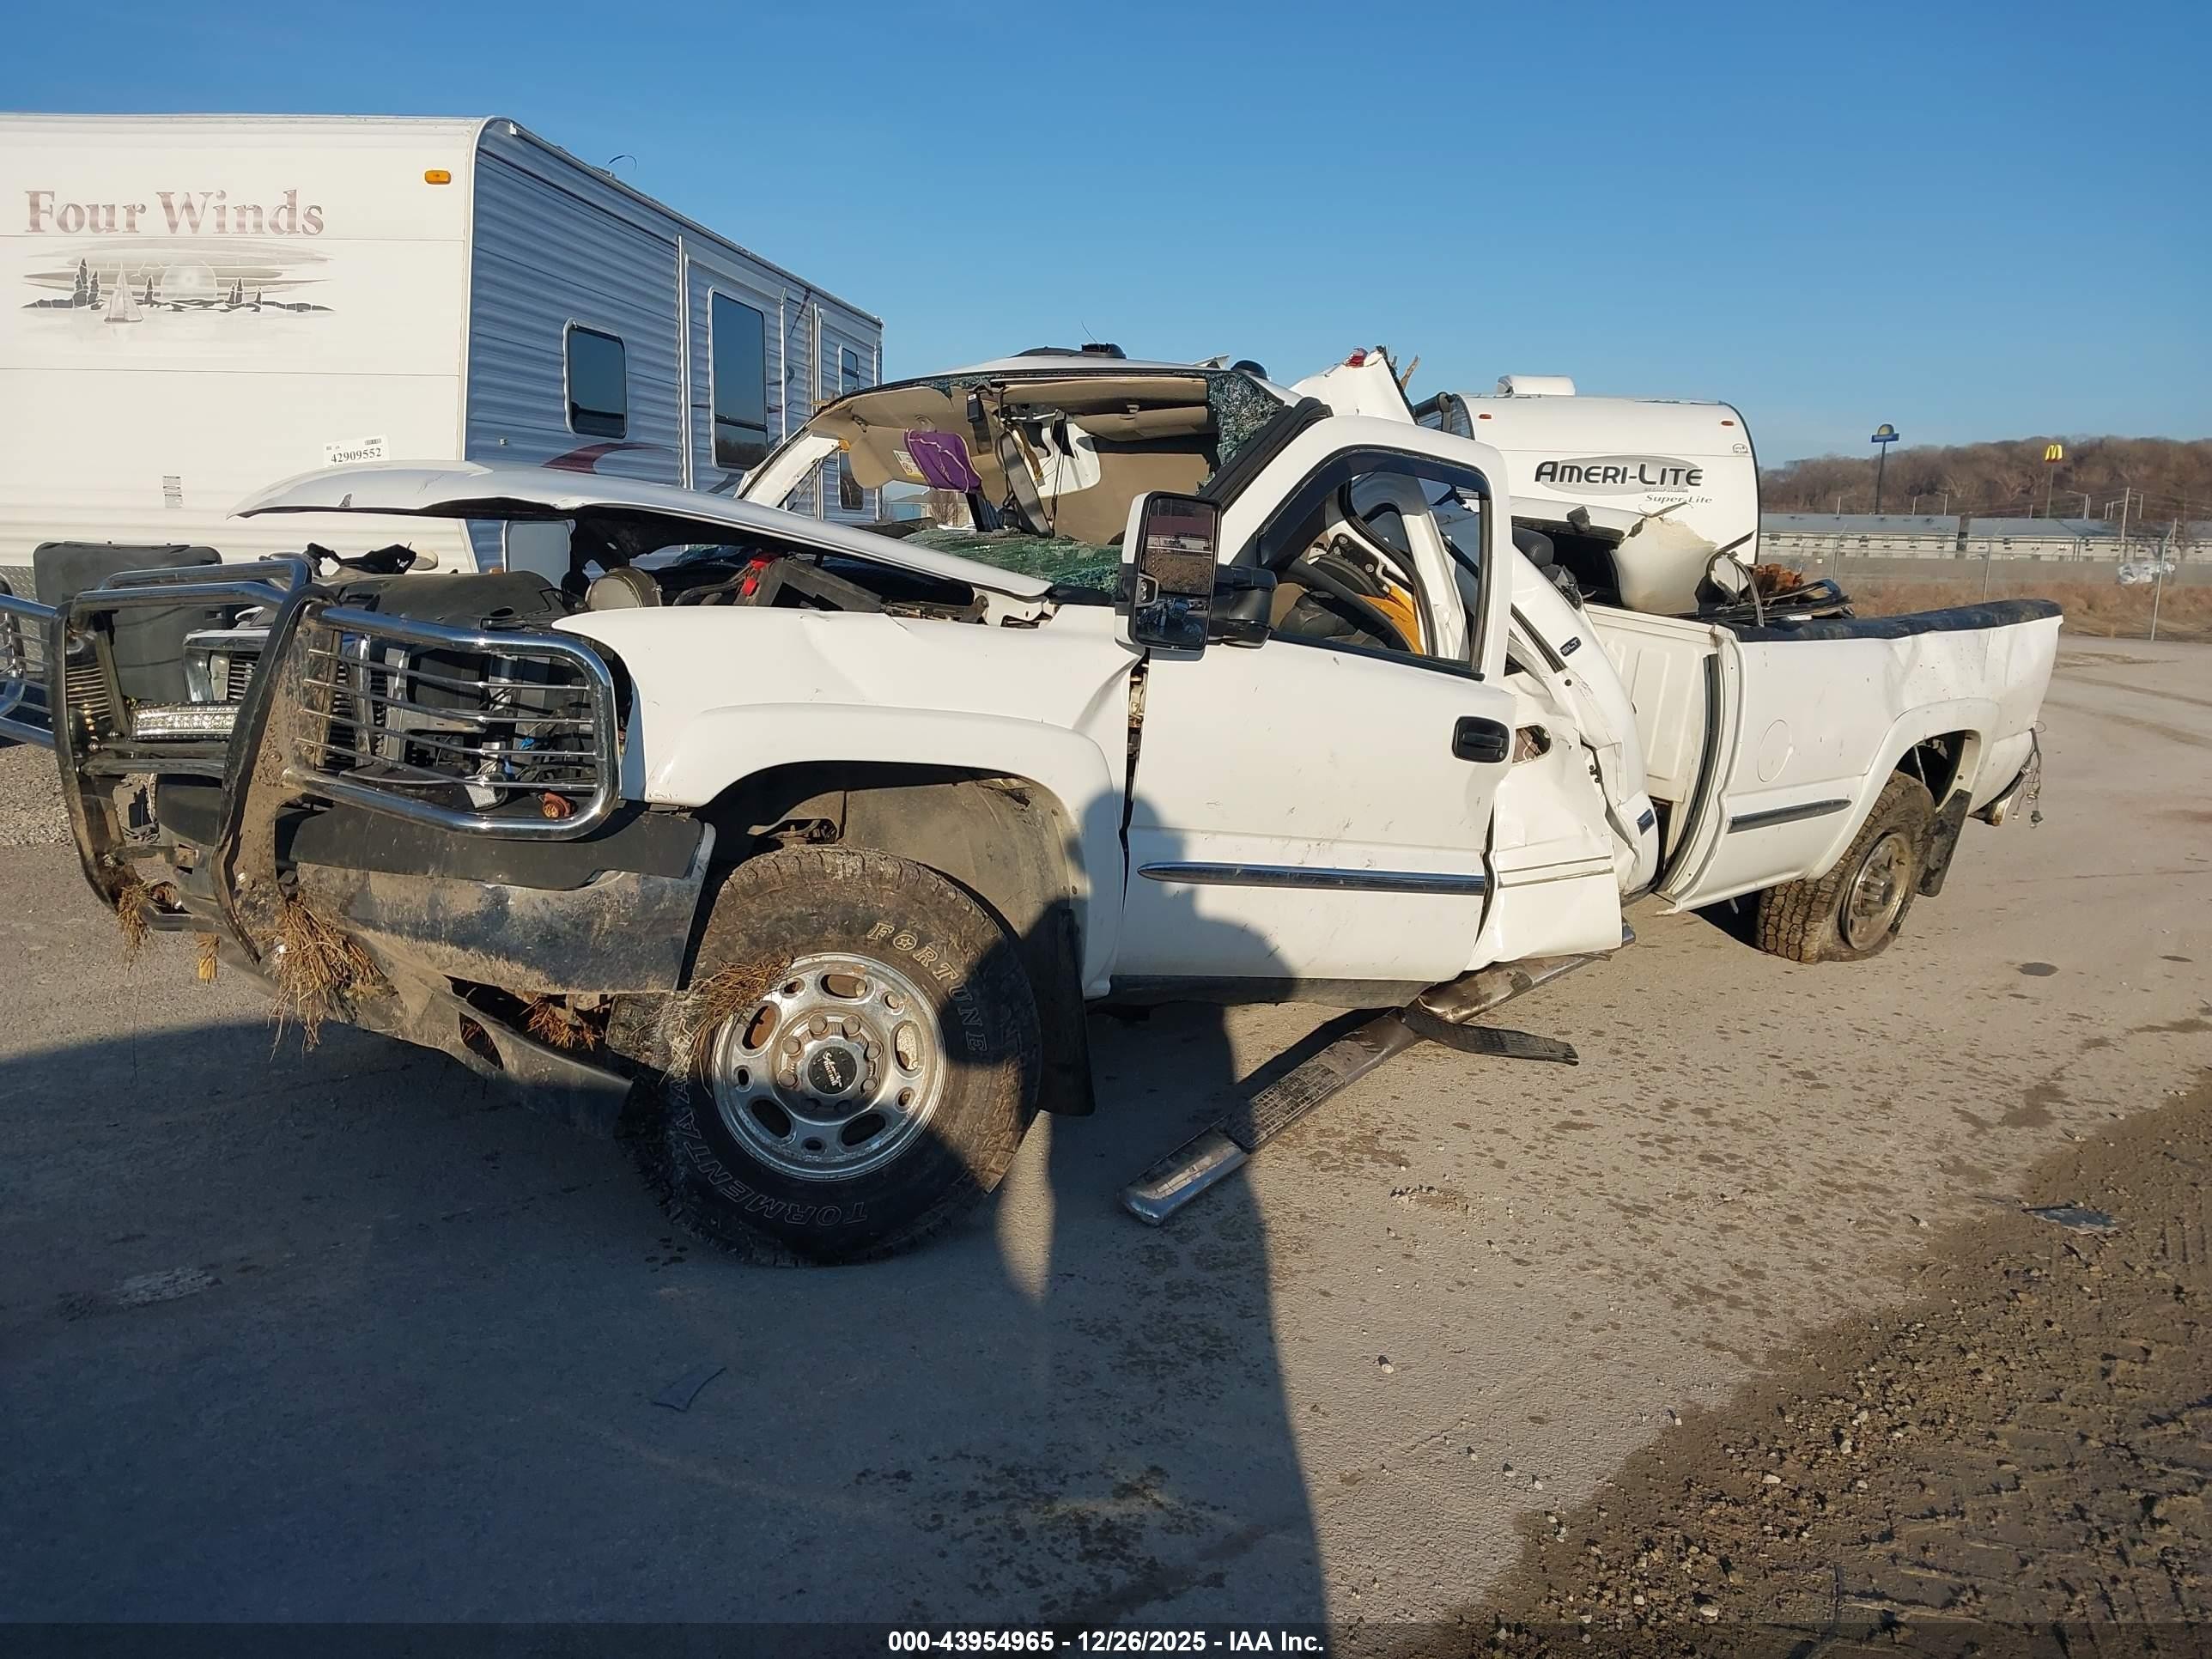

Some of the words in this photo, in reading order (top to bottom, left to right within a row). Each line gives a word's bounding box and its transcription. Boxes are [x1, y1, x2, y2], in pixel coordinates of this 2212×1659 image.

[25, 190, 147, 234] Four
[155, 188, 325, 236] Winds
[330, 447, 382, 464] 42909552
[1534, 460, 1704, 487] AMERI-LITE
